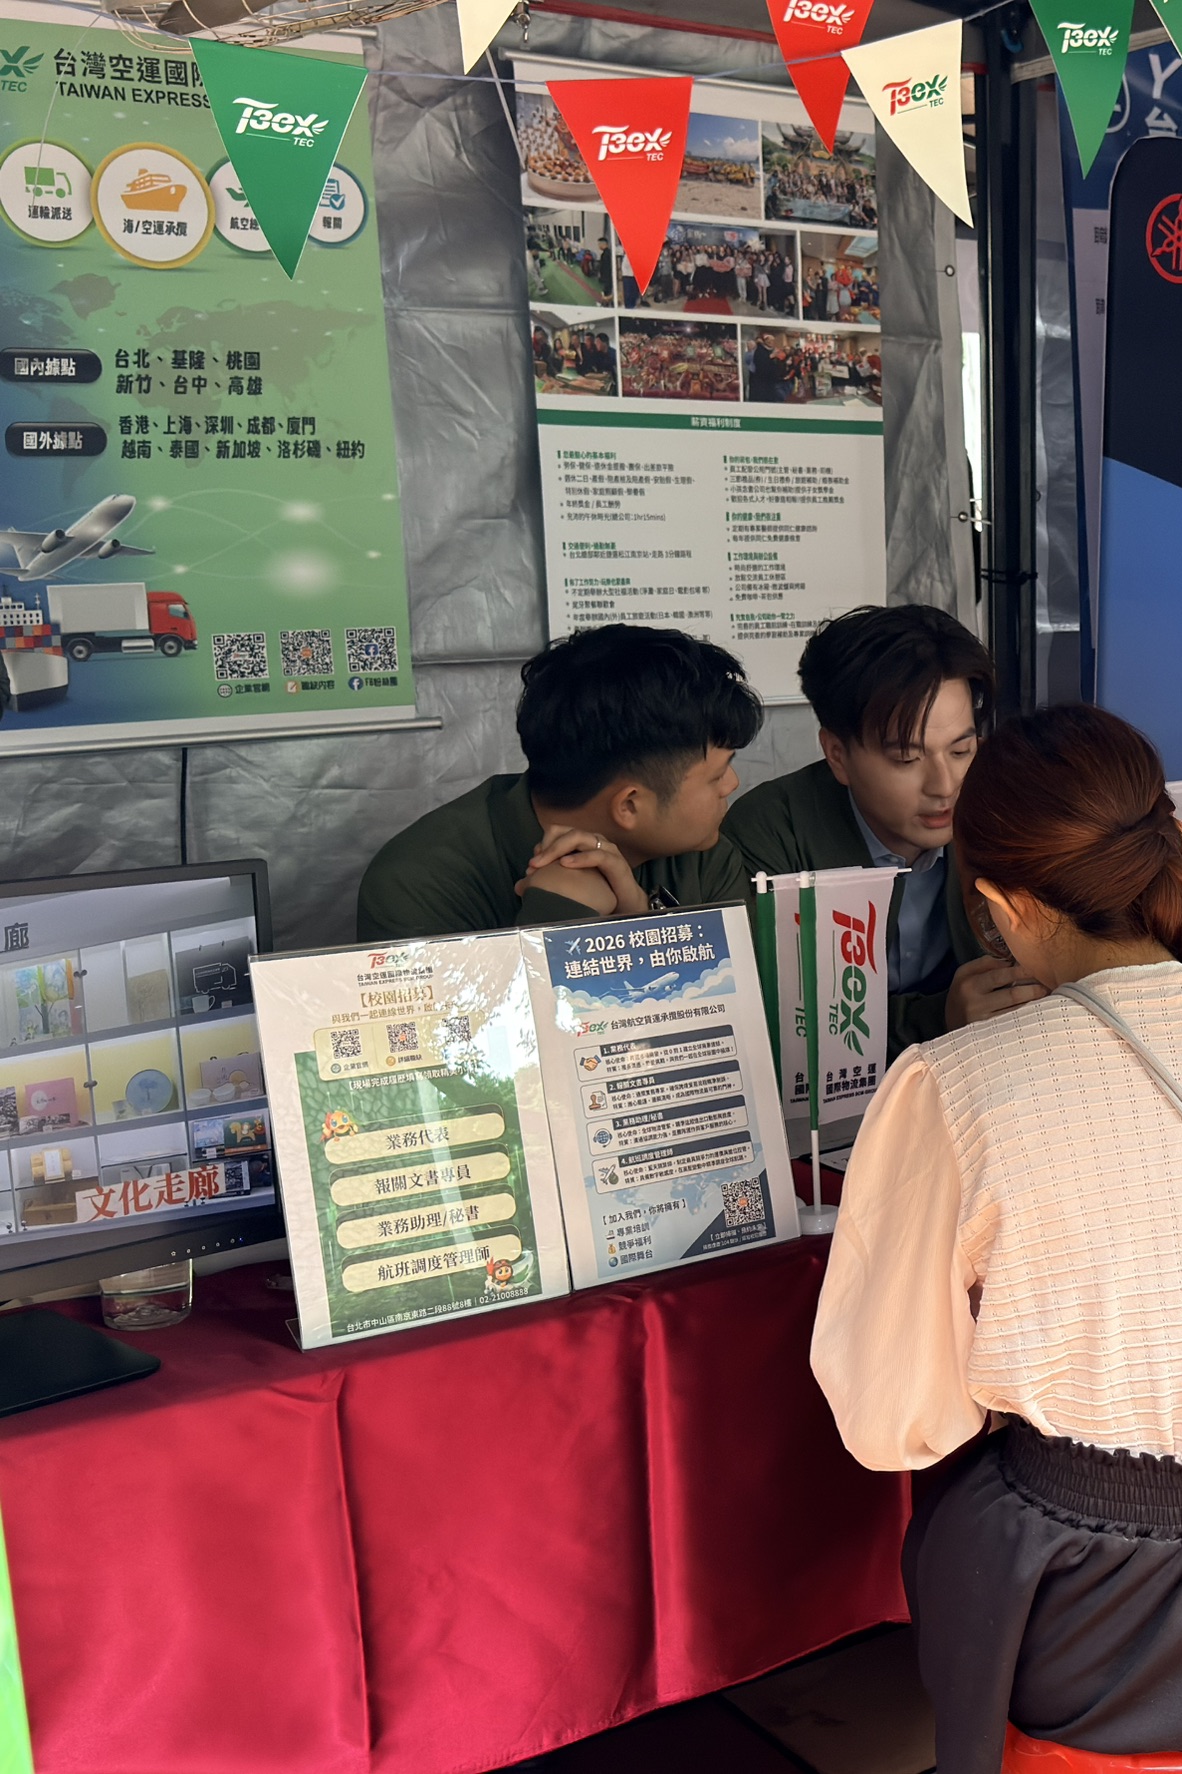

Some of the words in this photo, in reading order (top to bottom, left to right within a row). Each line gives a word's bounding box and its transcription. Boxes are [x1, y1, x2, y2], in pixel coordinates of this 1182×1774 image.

[827, 25, 843, 35] TEC
[1, 80, 28, 93] TEC
[56, 81, 126, 101] TAIWAN
[132, 88, 210, 108] EXPRESS
[929, 97, 944, 108] TEC
[293, 137, 314, 147] TEC
[646, 153, 664, 161] TEC
[28, 205, 73, 220] 運輸派送
[322, 216, 342, 229] 報關
[123, 219, 188, 236] 海/空運承攬
[14, 357, 76, 377] 國內據點
[114, 349, 261, 371] 台北、基隆、桃園
[116, 375, 263, 396] 新竹、台中、高雄
[118, 415, 316, 437] 香港、上海、深圳、成都、廈門
[23, 431, 83, 450] 國外據點
[121, 440, 365, 460] 越南、泰國、新加坡、洛杉磯、紐約
[4, 922, 29, 952] 廊
[585, 934, 625, 953] 2026
[629, 924, 704, 947] 校園招募：
[564, 942, 716, 980] 連結世界，由你啟航
[611, 1003, 726, 1030] 台灣航空貨運承攬股份有限公司
[829, 1003, 838, 1035] TEC
[826, 1063, 876, 1083] 台灣空運
[386, 1125, 450, 1151] 業務代表
[374, 1163, 471, 1195] 報關文書專員
[83, 1163, 223, 1222] 文化走廊
[377, 1204, 480, 1238] 業務助理/秘書
[617, 1222, 650, 1238] 專業培訓
[618, 1235, 652, 1251] 競爭福利
[377, 1246, 491, 1282] 航班調度管理師
[620, 1249, 653, 1265] 國際舞台
[347, 1299, 472, 1333] 台北市中山區南京東路二段88號8樓
[479, 1287, 529, 1305] 02-21008888
